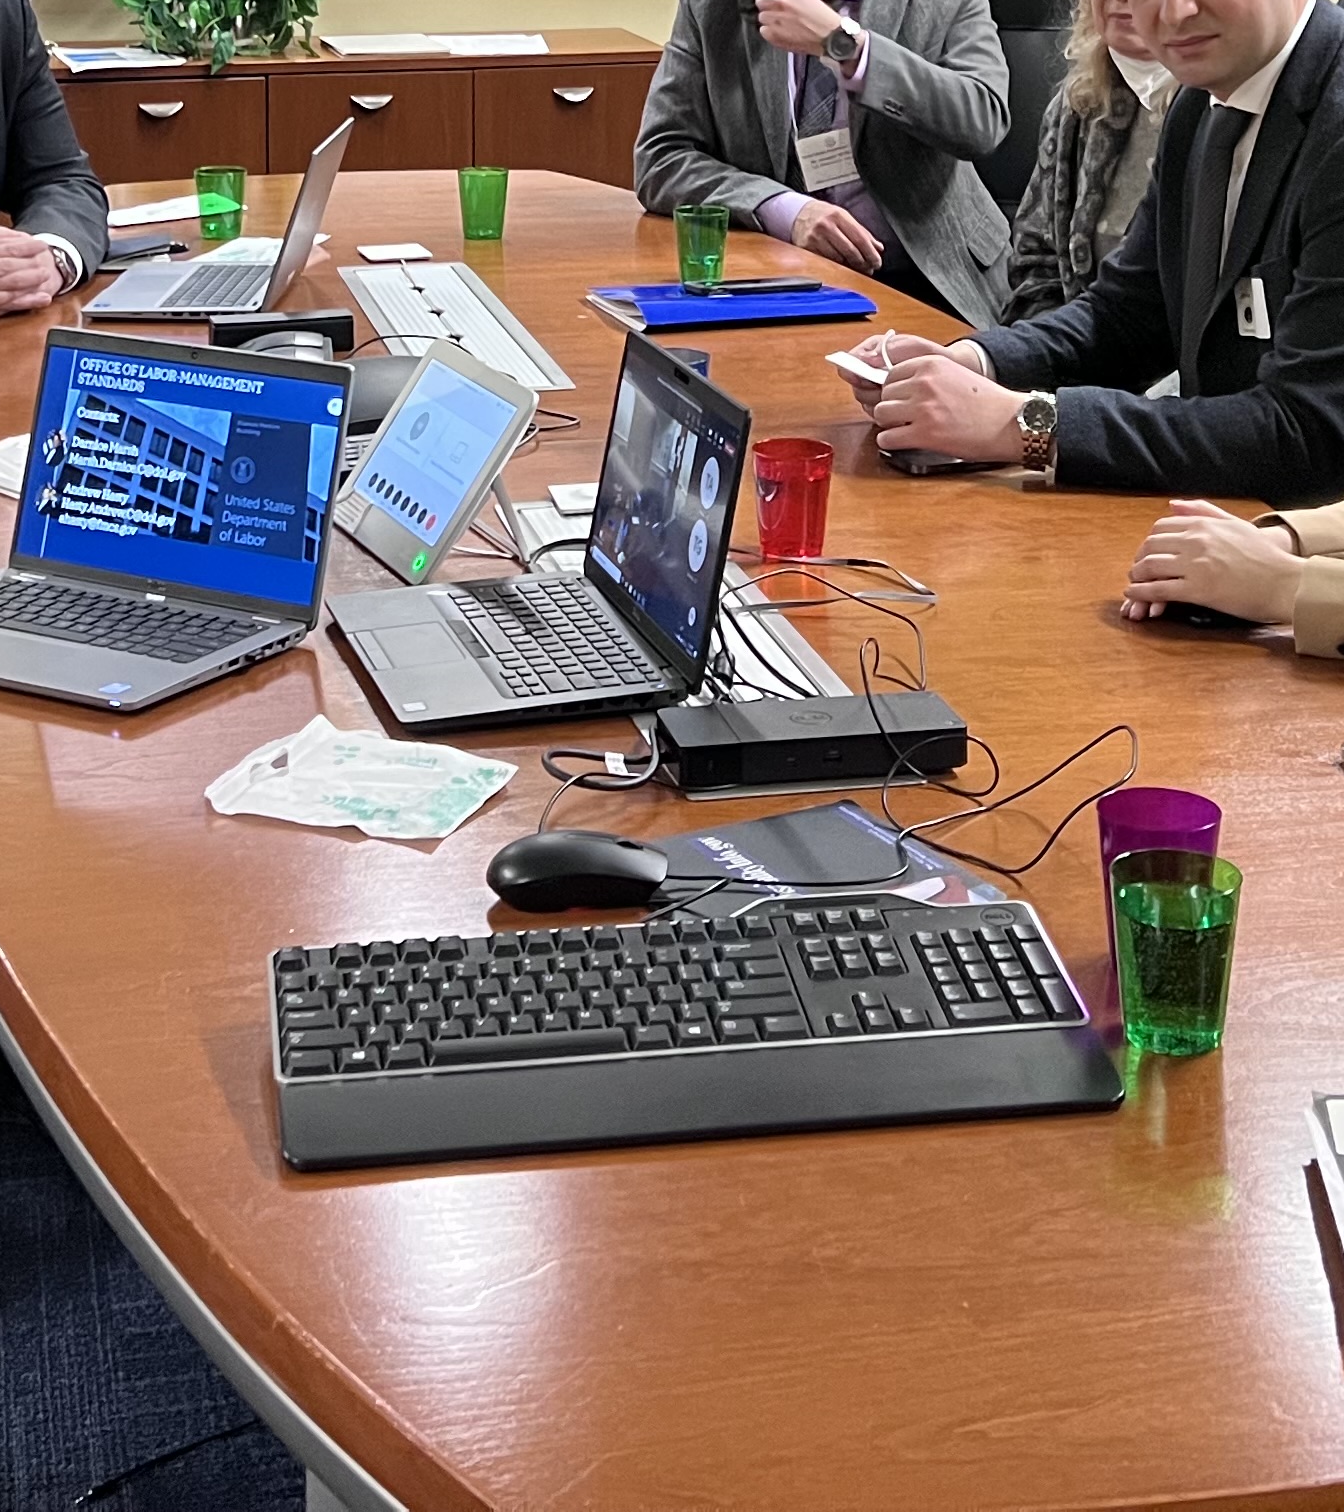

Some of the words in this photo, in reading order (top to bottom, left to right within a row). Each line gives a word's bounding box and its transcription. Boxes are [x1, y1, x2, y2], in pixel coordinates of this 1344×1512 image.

[77, 372, 145, 393] STANDARDS
[79, 357, 122, 375] OFFICE
[122, 363, 138, 377] OF
[138, 366, 265, 394] LABOR-MANAGEMENT
[224, 494, 261, 509] United
[263, 498, 296, 515] States
[221, 510, 287, 532] Department
[219, 528, 233, 541] of
[234, 530, 267, 547] Labor
